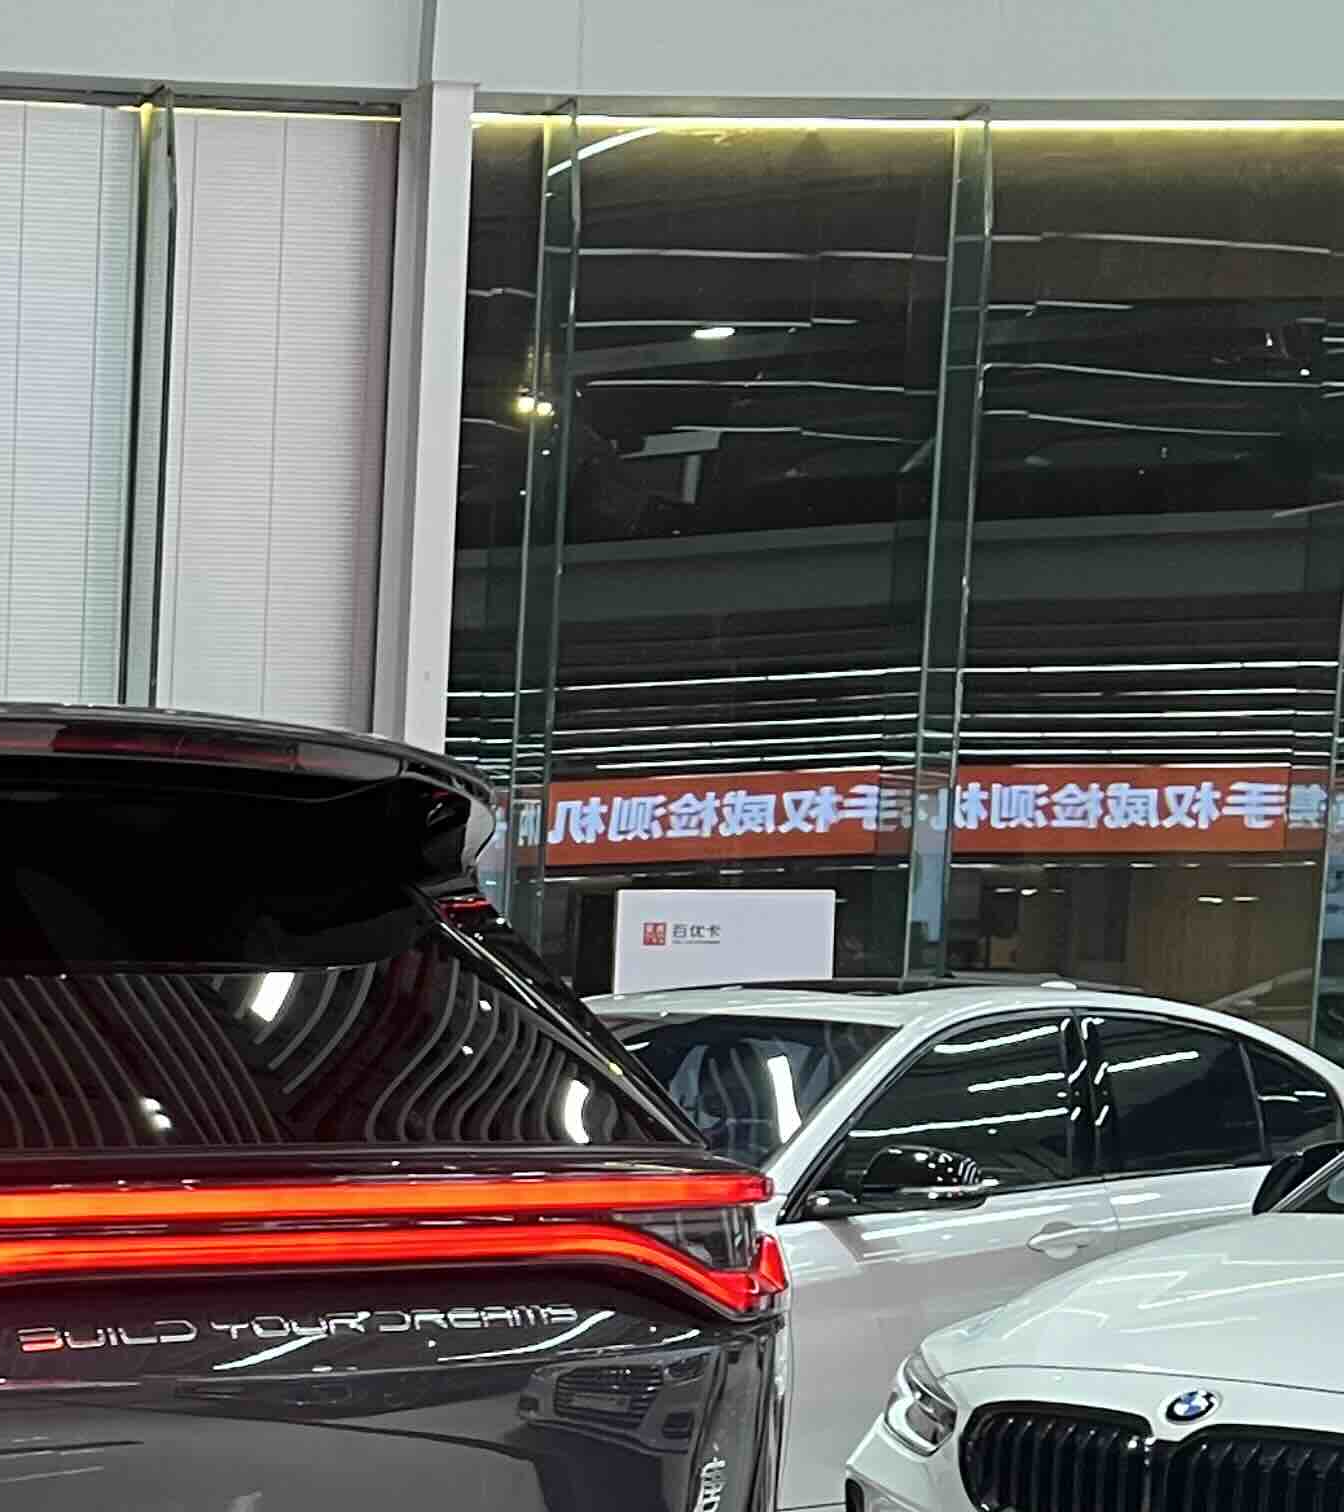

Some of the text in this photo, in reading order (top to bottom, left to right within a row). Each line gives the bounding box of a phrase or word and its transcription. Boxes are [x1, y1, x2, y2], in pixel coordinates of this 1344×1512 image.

[17, 1303, 578, 1352] BUILD YOUR DREAMS
